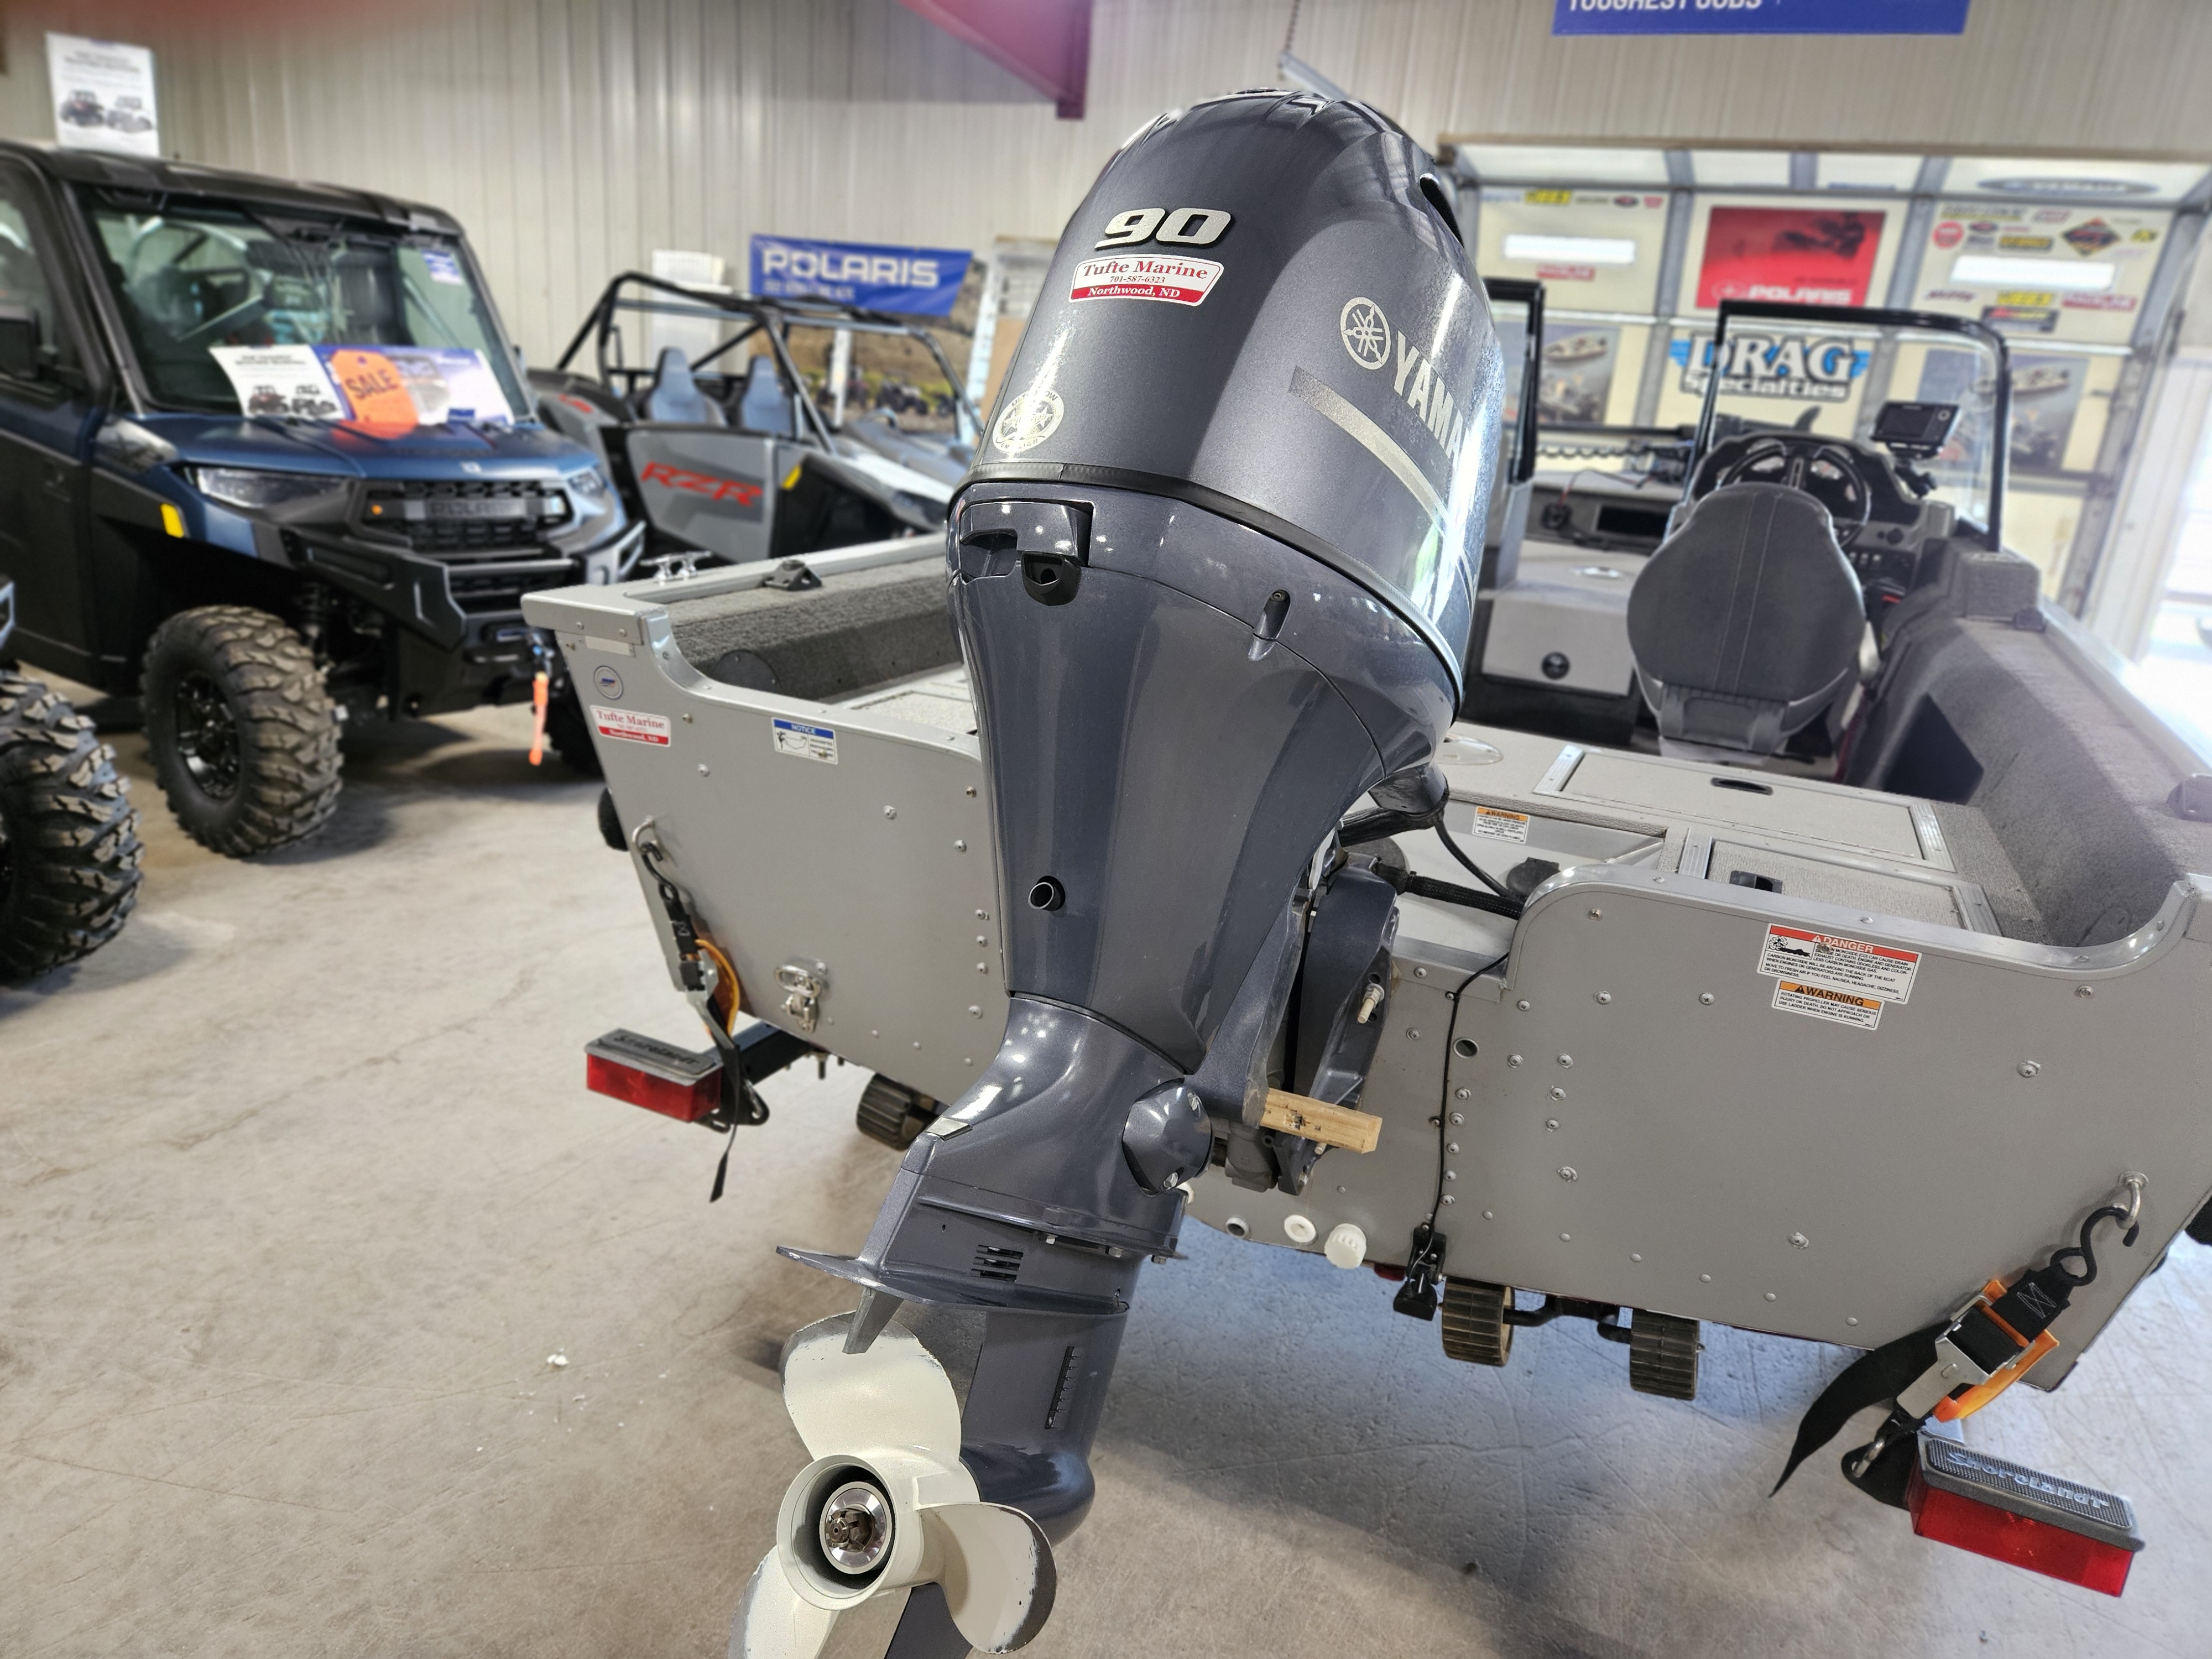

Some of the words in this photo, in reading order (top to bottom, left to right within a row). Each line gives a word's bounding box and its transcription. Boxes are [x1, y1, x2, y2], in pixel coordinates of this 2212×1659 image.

[1094, 207, 1231, 249] 90
[763, 248, 938, 289] POLARIS
[1083, 261, 1129, 277] Tufte
[1134, 260, 1208, 279] Marine
[1109, 275, 1166, 284] 701-587-6323
[1087, 285, 1156, 297] Northwood,
[1160, 288, 1181, 298] ND
[1689, 335, 1856, 383] DRAG
[345, 369, 399, 400] SALE
[1394, 330, 1471, 473] YAMA
[640, 461, 763, 507] RZR
[596, 709, 624, 722] Tufte
[626, 714, 665, 729] Marine
[791, 723, 816, 734] NOTICE
[1822, 937, 1874, 953] DANGER
[1806, 965, 1834, 974] GENERATORS
[1884, 962, 1911, 971] GENERATOR
[1803, 996, 1829, 1005] PROPELLER
[1806, 987, 1864, 1006] WARNING
[1837, 1009, 1862, 1017] APPROACH
